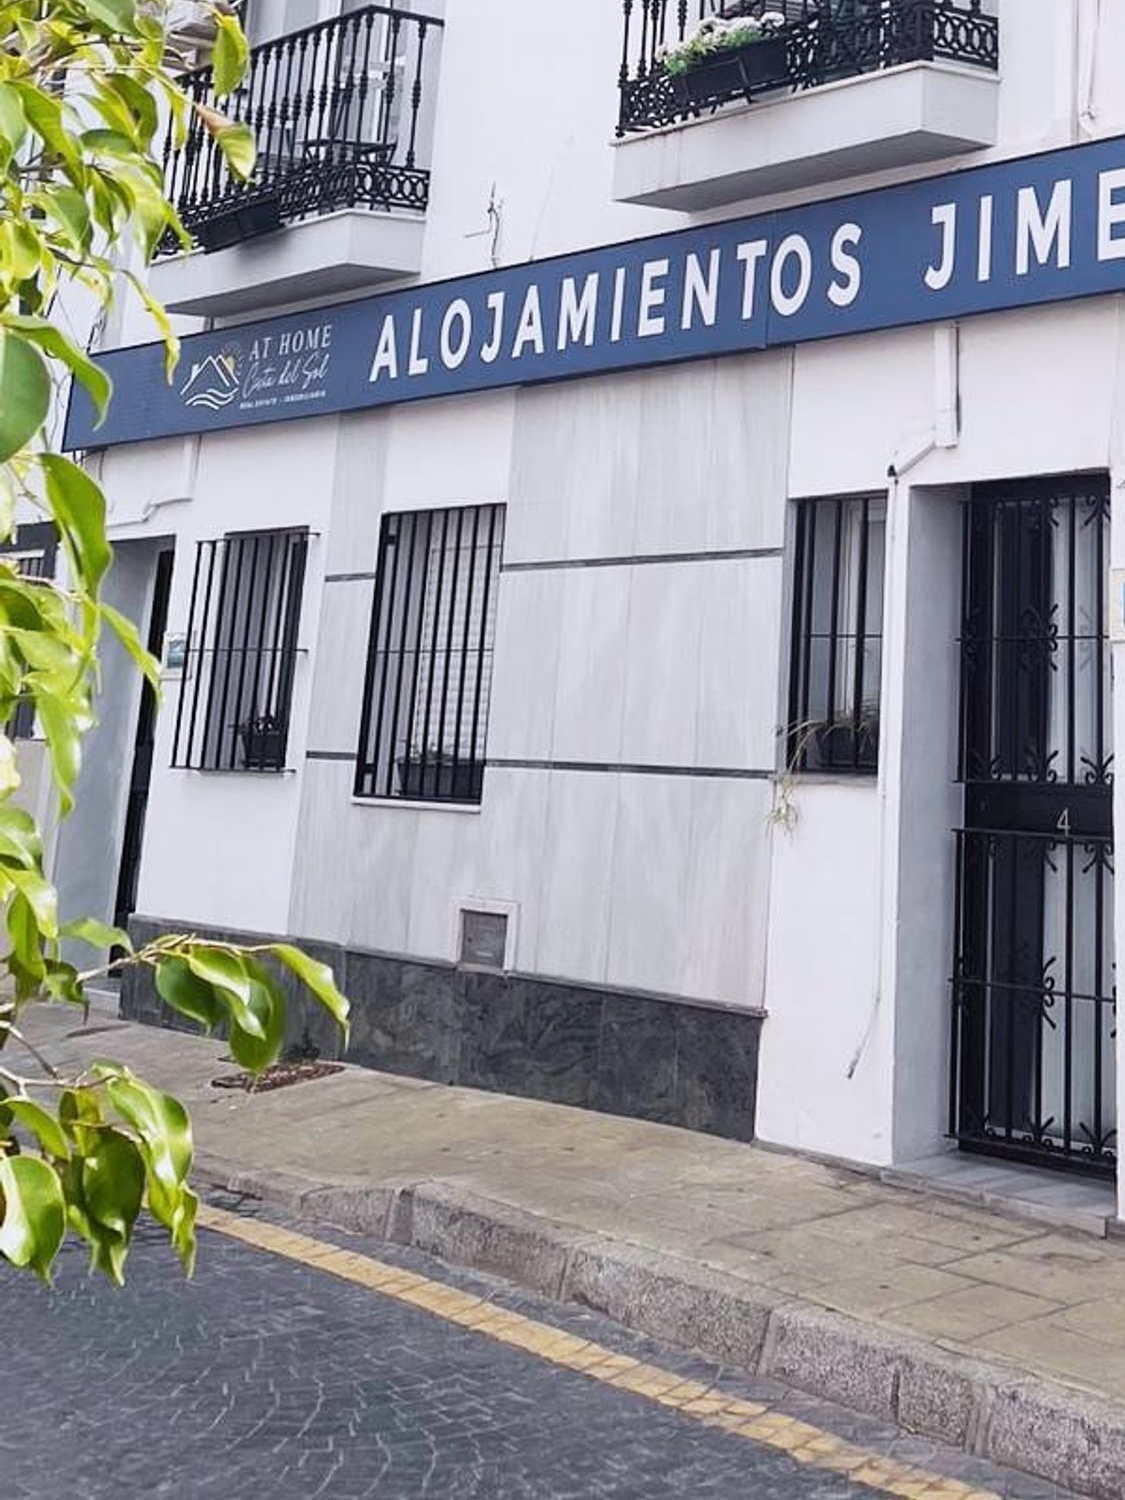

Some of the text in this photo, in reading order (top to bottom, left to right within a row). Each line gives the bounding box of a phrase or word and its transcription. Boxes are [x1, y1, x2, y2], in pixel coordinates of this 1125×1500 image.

[368, 222, 863, 382] ALOJAMIENTOS
[249, 324, 332, 361] AT HOME
[1056, 808, 1071, 837] 4
